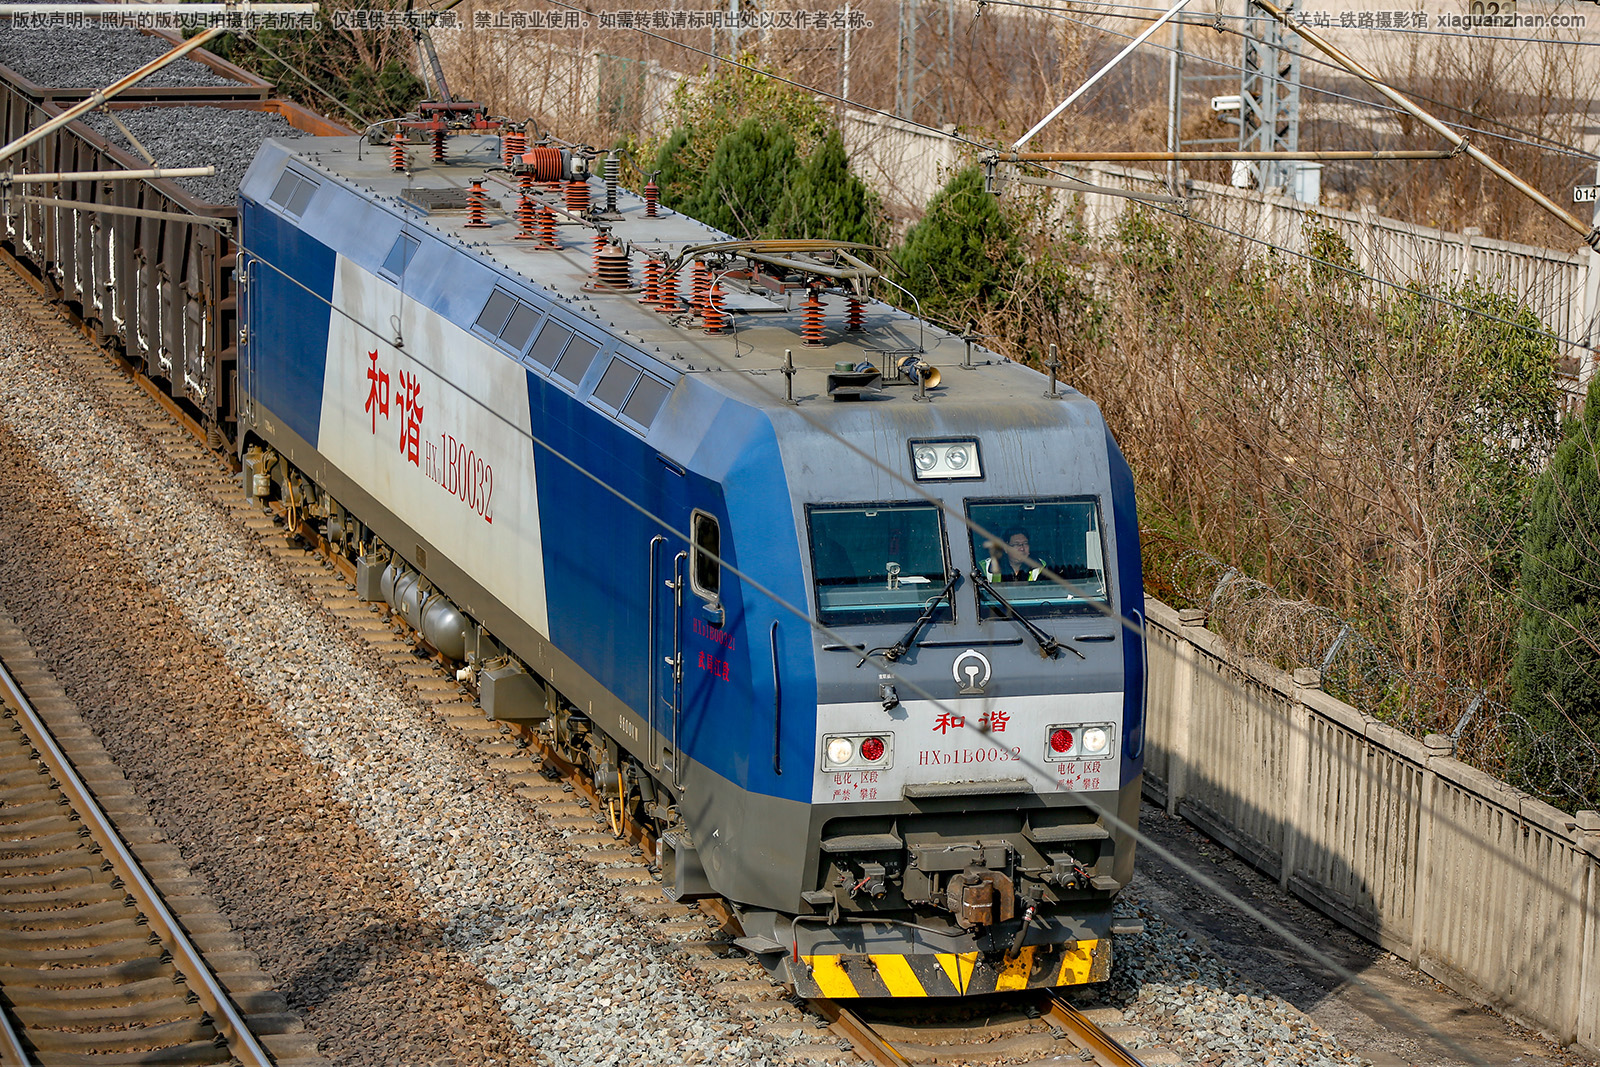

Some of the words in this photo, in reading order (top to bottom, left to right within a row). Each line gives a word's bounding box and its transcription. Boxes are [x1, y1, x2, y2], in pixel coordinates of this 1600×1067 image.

[1576, 189, 1596, 200] 014
[364, 349, 424, 468] 和谐
[919, 746, 1021, 766] HXD1B0032
